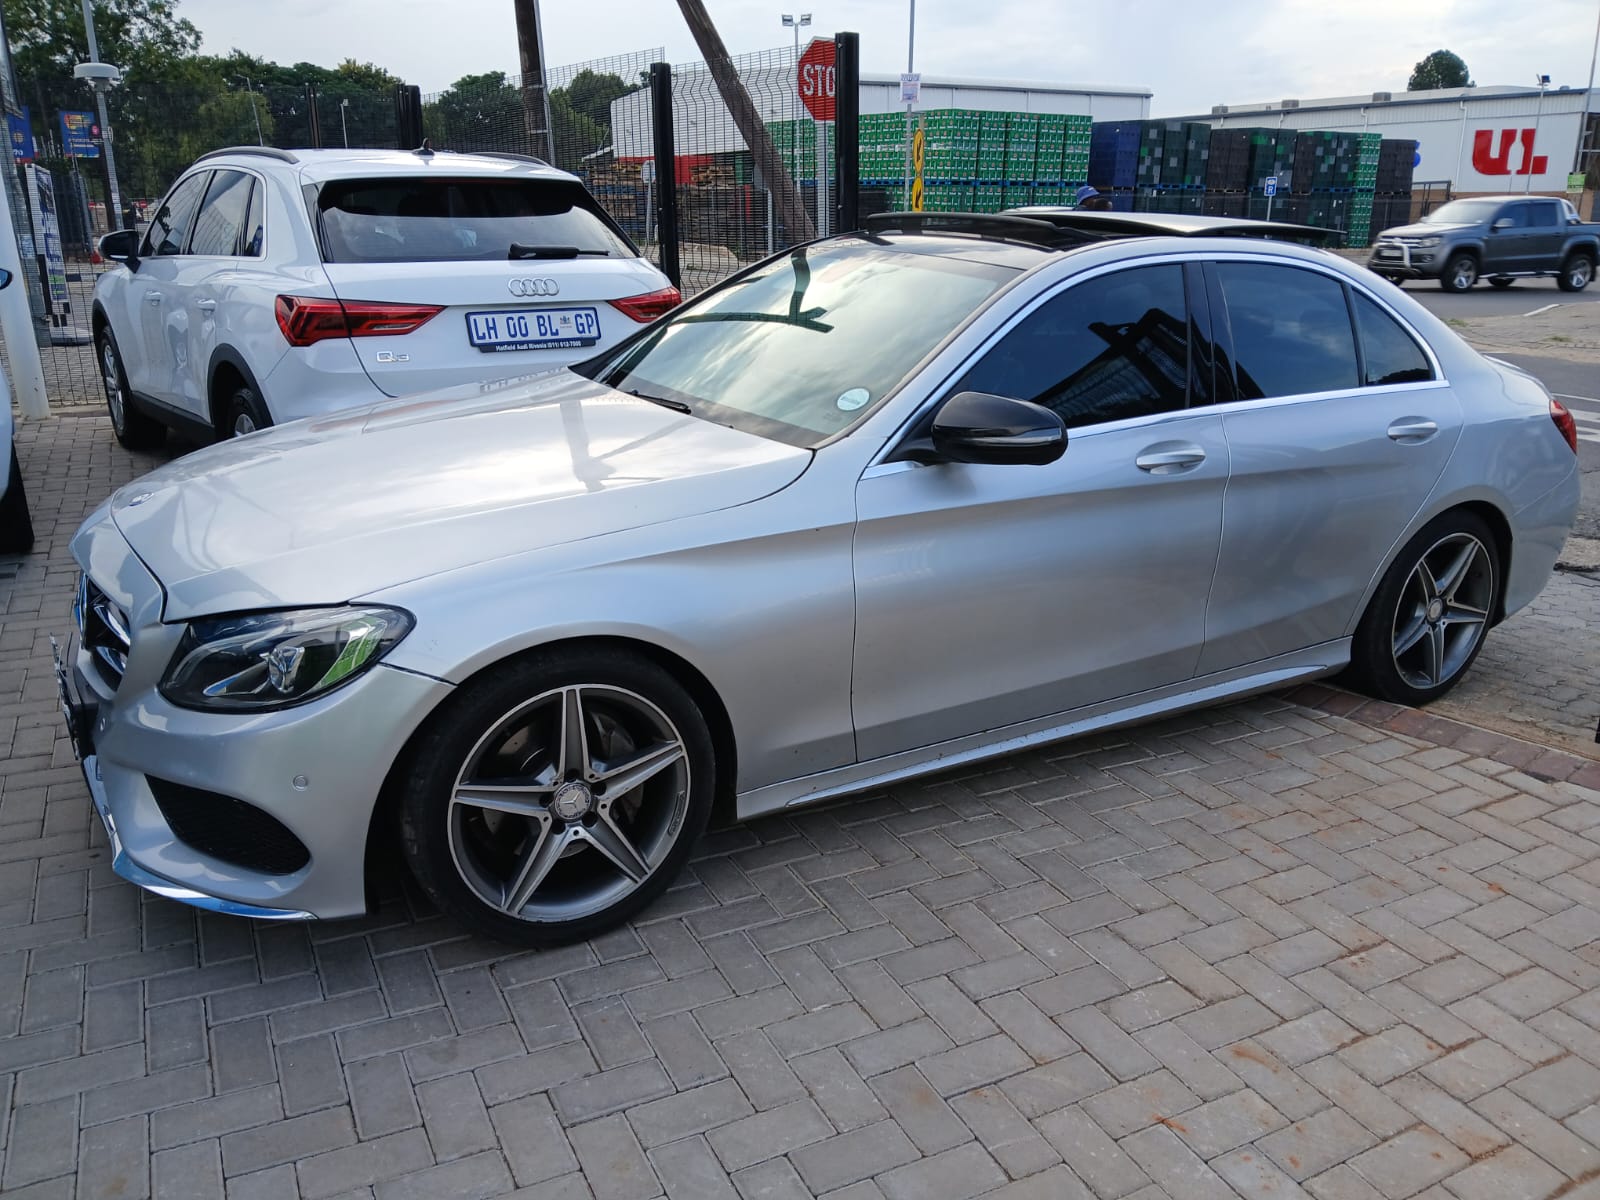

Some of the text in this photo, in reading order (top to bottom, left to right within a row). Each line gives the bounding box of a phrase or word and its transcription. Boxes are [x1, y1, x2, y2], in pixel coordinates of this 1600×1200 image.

[803, 63, 836, 97] STO
[473, 317, 498, 340] LH
[536, 314, 559, 337] BL
[574, 313, 595, 335] GP
[376, 351, 410, 362] Q3
